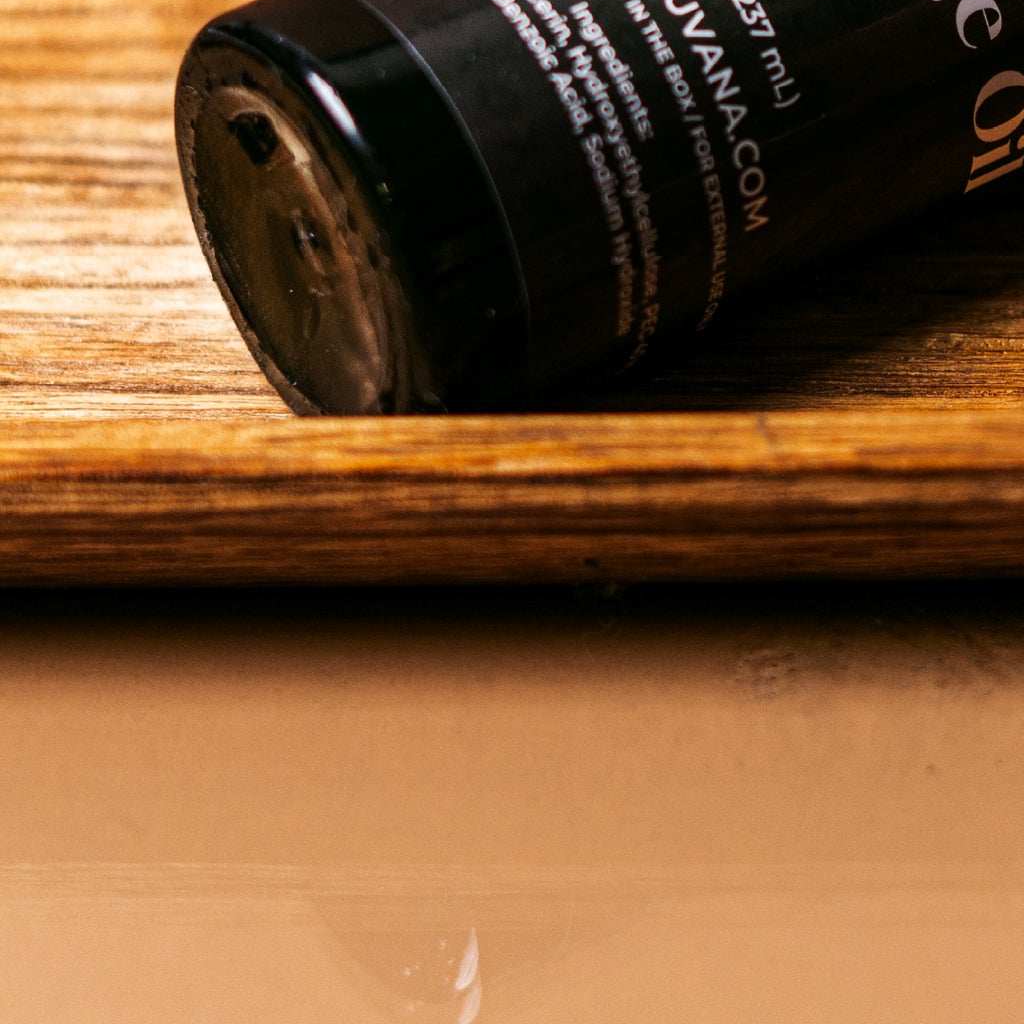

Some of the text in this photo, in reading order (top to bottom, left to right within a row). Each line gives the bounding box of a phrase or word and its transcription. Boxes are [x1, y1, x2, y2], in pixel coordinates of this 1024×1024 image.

[568, 0, 656, 143] Ingredients:
[641, 19, 676, 65] THE
[662, 63, 697, 113] BOX
[760, 46, 801, 110] mL)
[689, 124, 716, 175] FOR
[579, 132, 625, 232] Sodium
[702, 173, 729, 274] EXTERNAL
